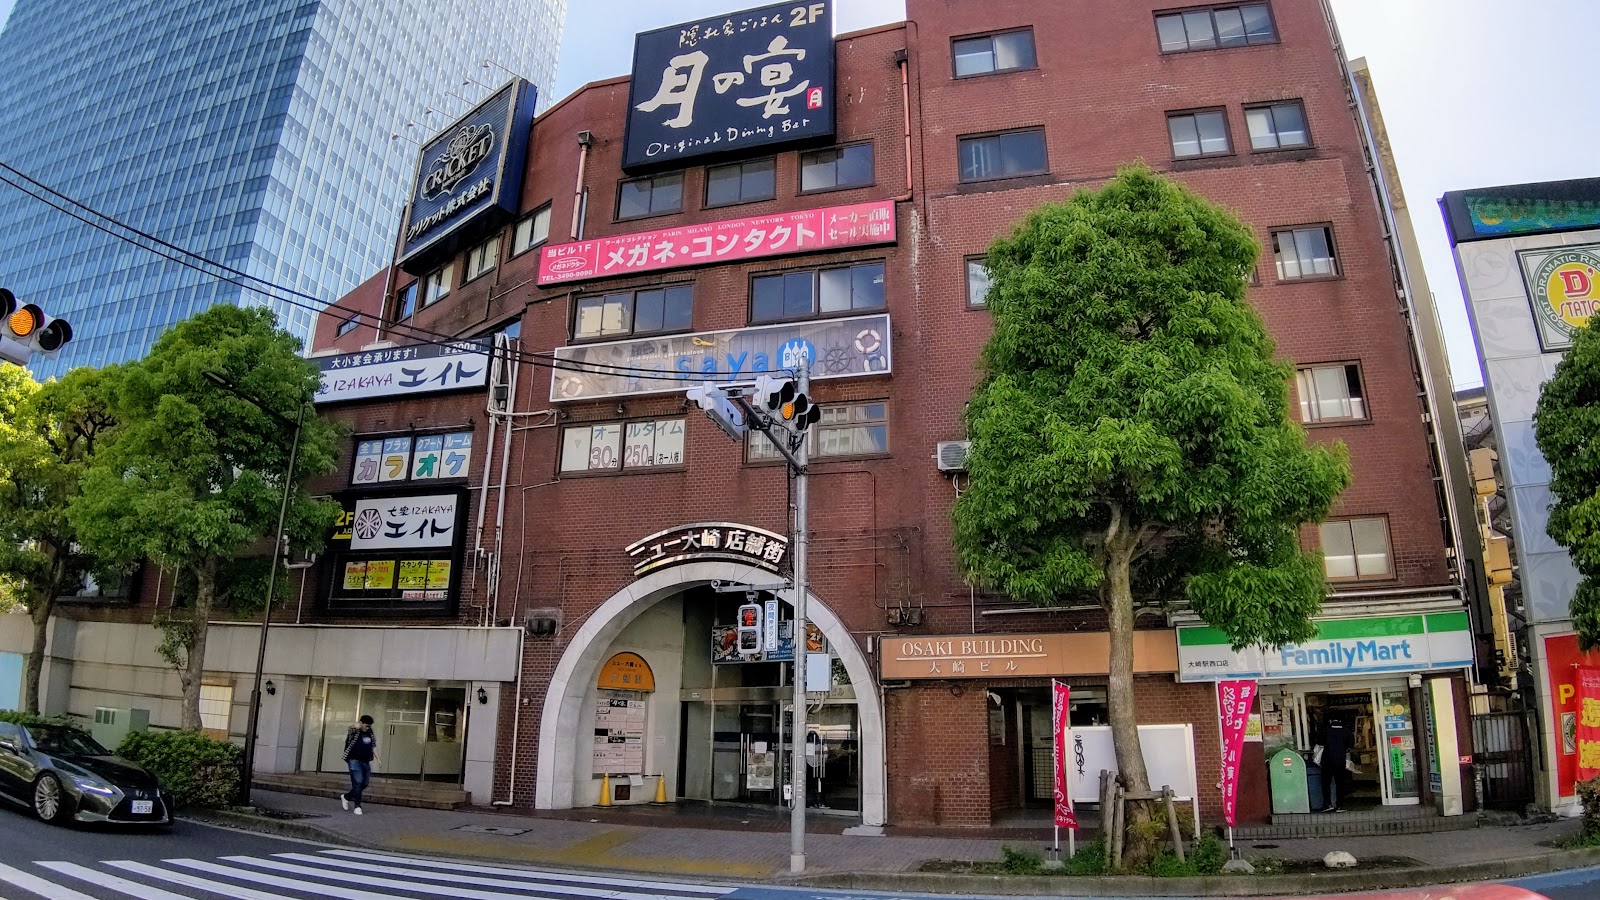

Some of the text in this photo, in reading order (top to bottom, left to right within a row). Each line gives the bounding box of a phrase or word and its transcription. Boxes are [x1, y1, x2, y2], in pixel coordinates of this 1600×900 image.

[790, 3, 825, 27] 2F
[634, 35, 810, 129] 月の宴
[809, 89, 822, 108] 月
[646, 118, 810, 157] Original Dining Bar
[423, 134, 491, 194] CRICKET
[407, 176, 492, 242] クリケット株式会社
[829, 208, 890, 226] メーカー直販
[687, 226, 713, 234] MILANO
[718, 222, 745, 230] LONDON
[751, 216, 785, 225] NEWYORK
[790, 213, 815, 221] TOKYO
[828, 222, 890, 240] セール実施中
[603, 223, 816, 271] メガネ・コンタクト
[1537, 254, 1577, 296] DRAMATIC
[399, 360, 483, 387] エイト
[676, 351, 769, 382] saya
[333, 373, 393, 391] IZAKAYA
[594, 421, 683, 440] オールタイム
[357, 451, 466, 481] カラオケ
[412, 504, 453, 515] IZAKAYA
[384, 518, 452, 539] エイト
[902, 638, 1043, 656] OSAKI BUILDING
[1281, 639, 1412, 667] FamilyMart
[929, 660, 1018, 674] 大崎ビル
[1188, 659, 1229, 668] 大崎駅西口店
[1423, 692, 1436, 764] FamilyMart
